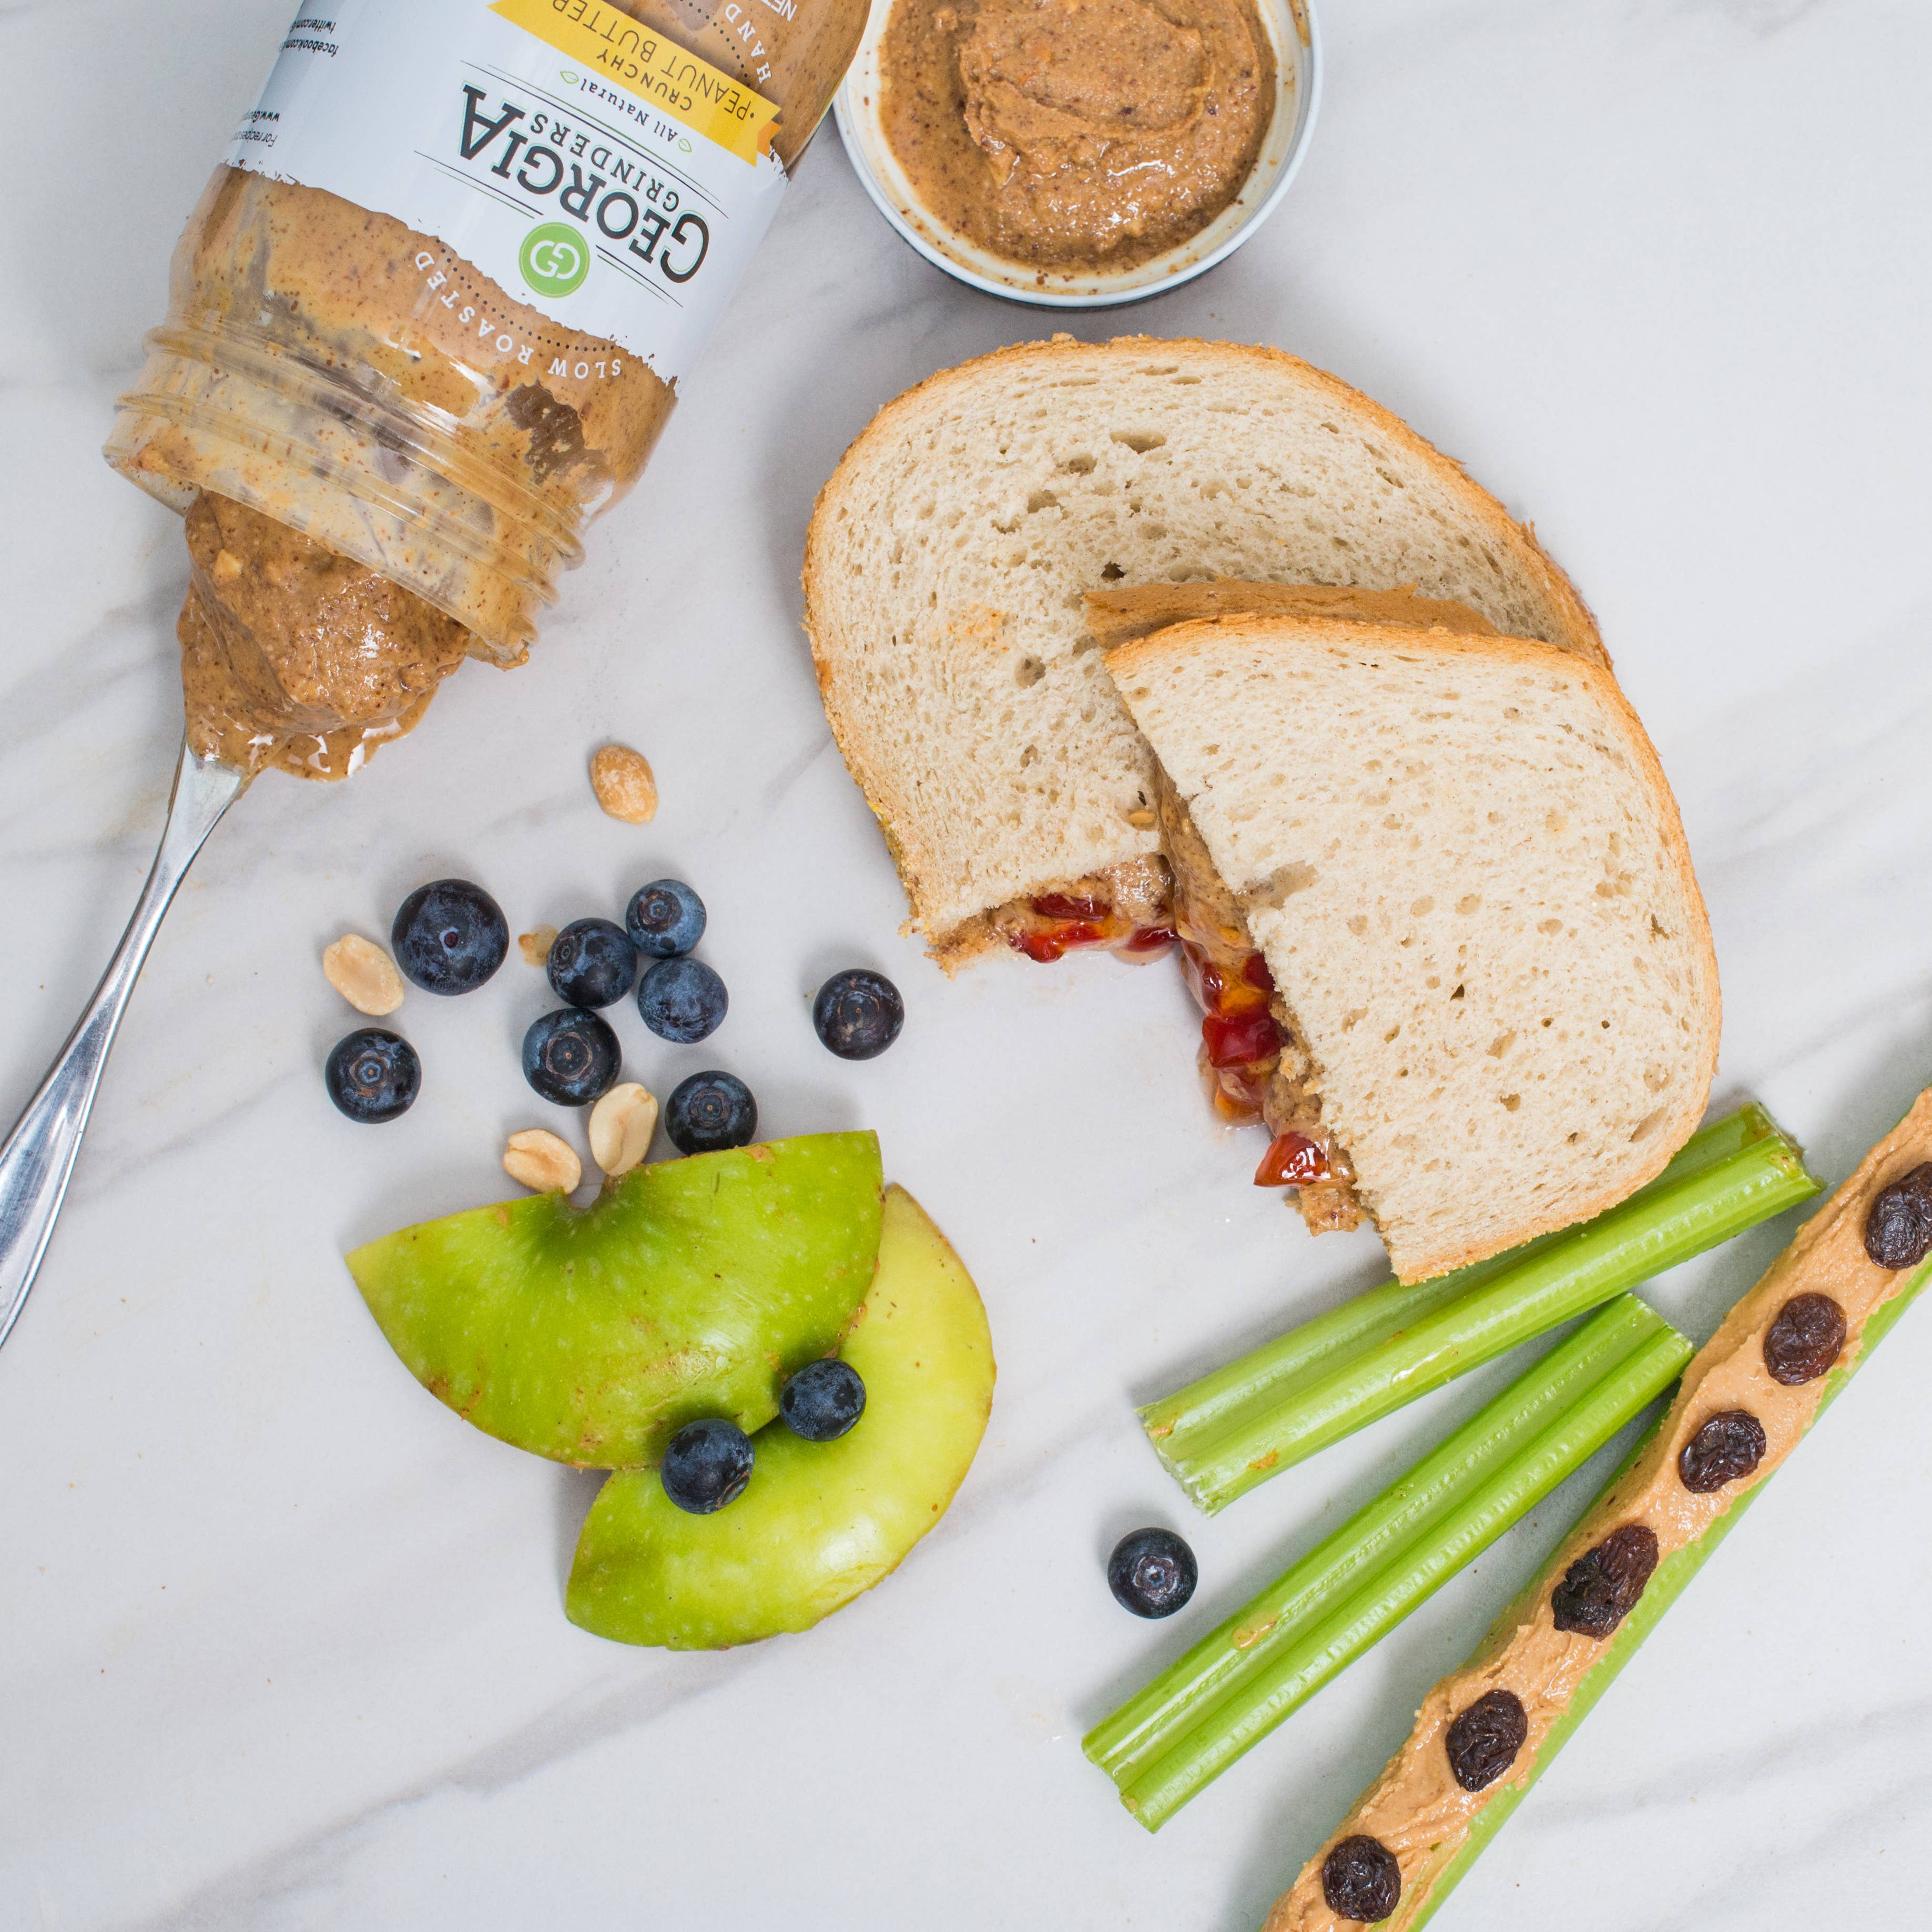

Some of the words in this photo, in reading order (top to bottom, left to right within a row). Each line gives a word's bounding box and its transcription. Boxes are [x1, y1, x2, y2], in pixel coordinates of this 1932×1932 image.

[725, 3, 772, 84] HAND
[581, 78, 649, 127] Natural
[596, 48, 693, 111] CRUNCHY
[261, 133, 278, 147] For
[529, 113, 680, 213] GRINDERS
[654, 127, 678, 143] All
[459, 83, 711, 284] GEORGIA
[414, 251, 532, 367] ROASTED
[550, 358, 622, 381] SLOW
